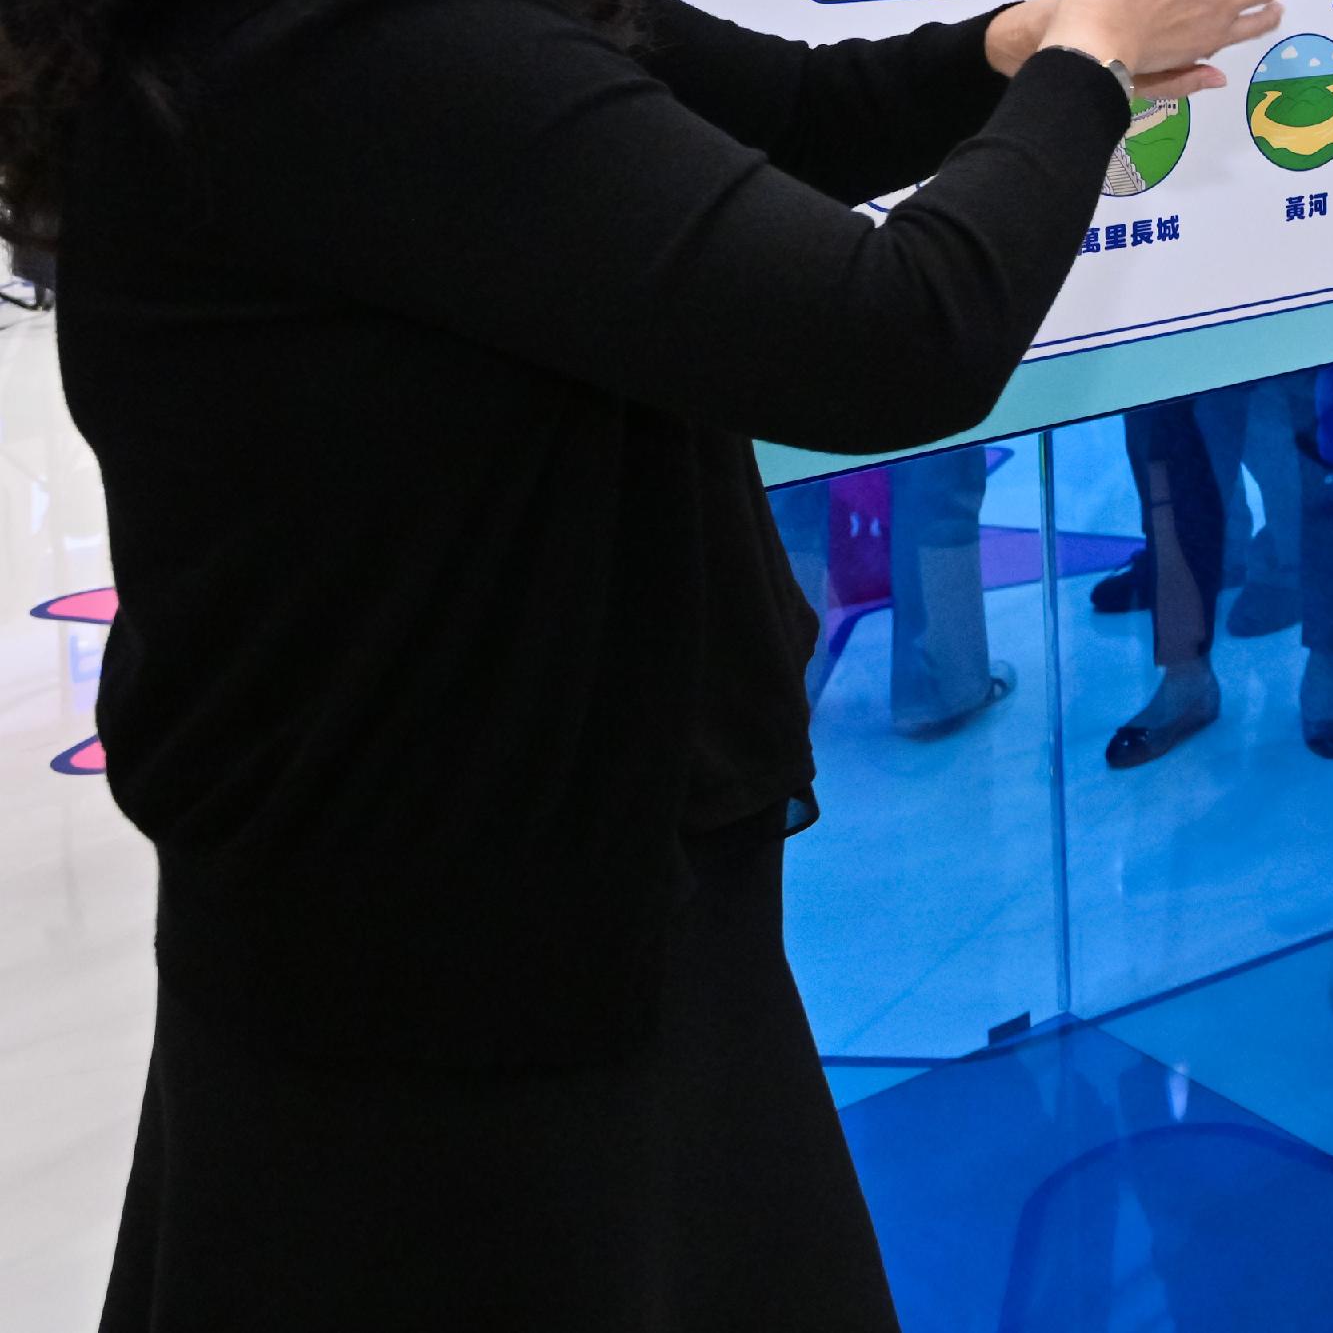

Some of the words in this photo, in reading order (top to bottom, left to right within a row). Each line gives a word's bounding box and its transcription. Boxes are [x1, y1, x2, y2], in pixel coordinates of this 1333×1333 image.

[1285, 192, 1328, 222] 黃河
[1078, 215, 1180, 255] 萬里長城
